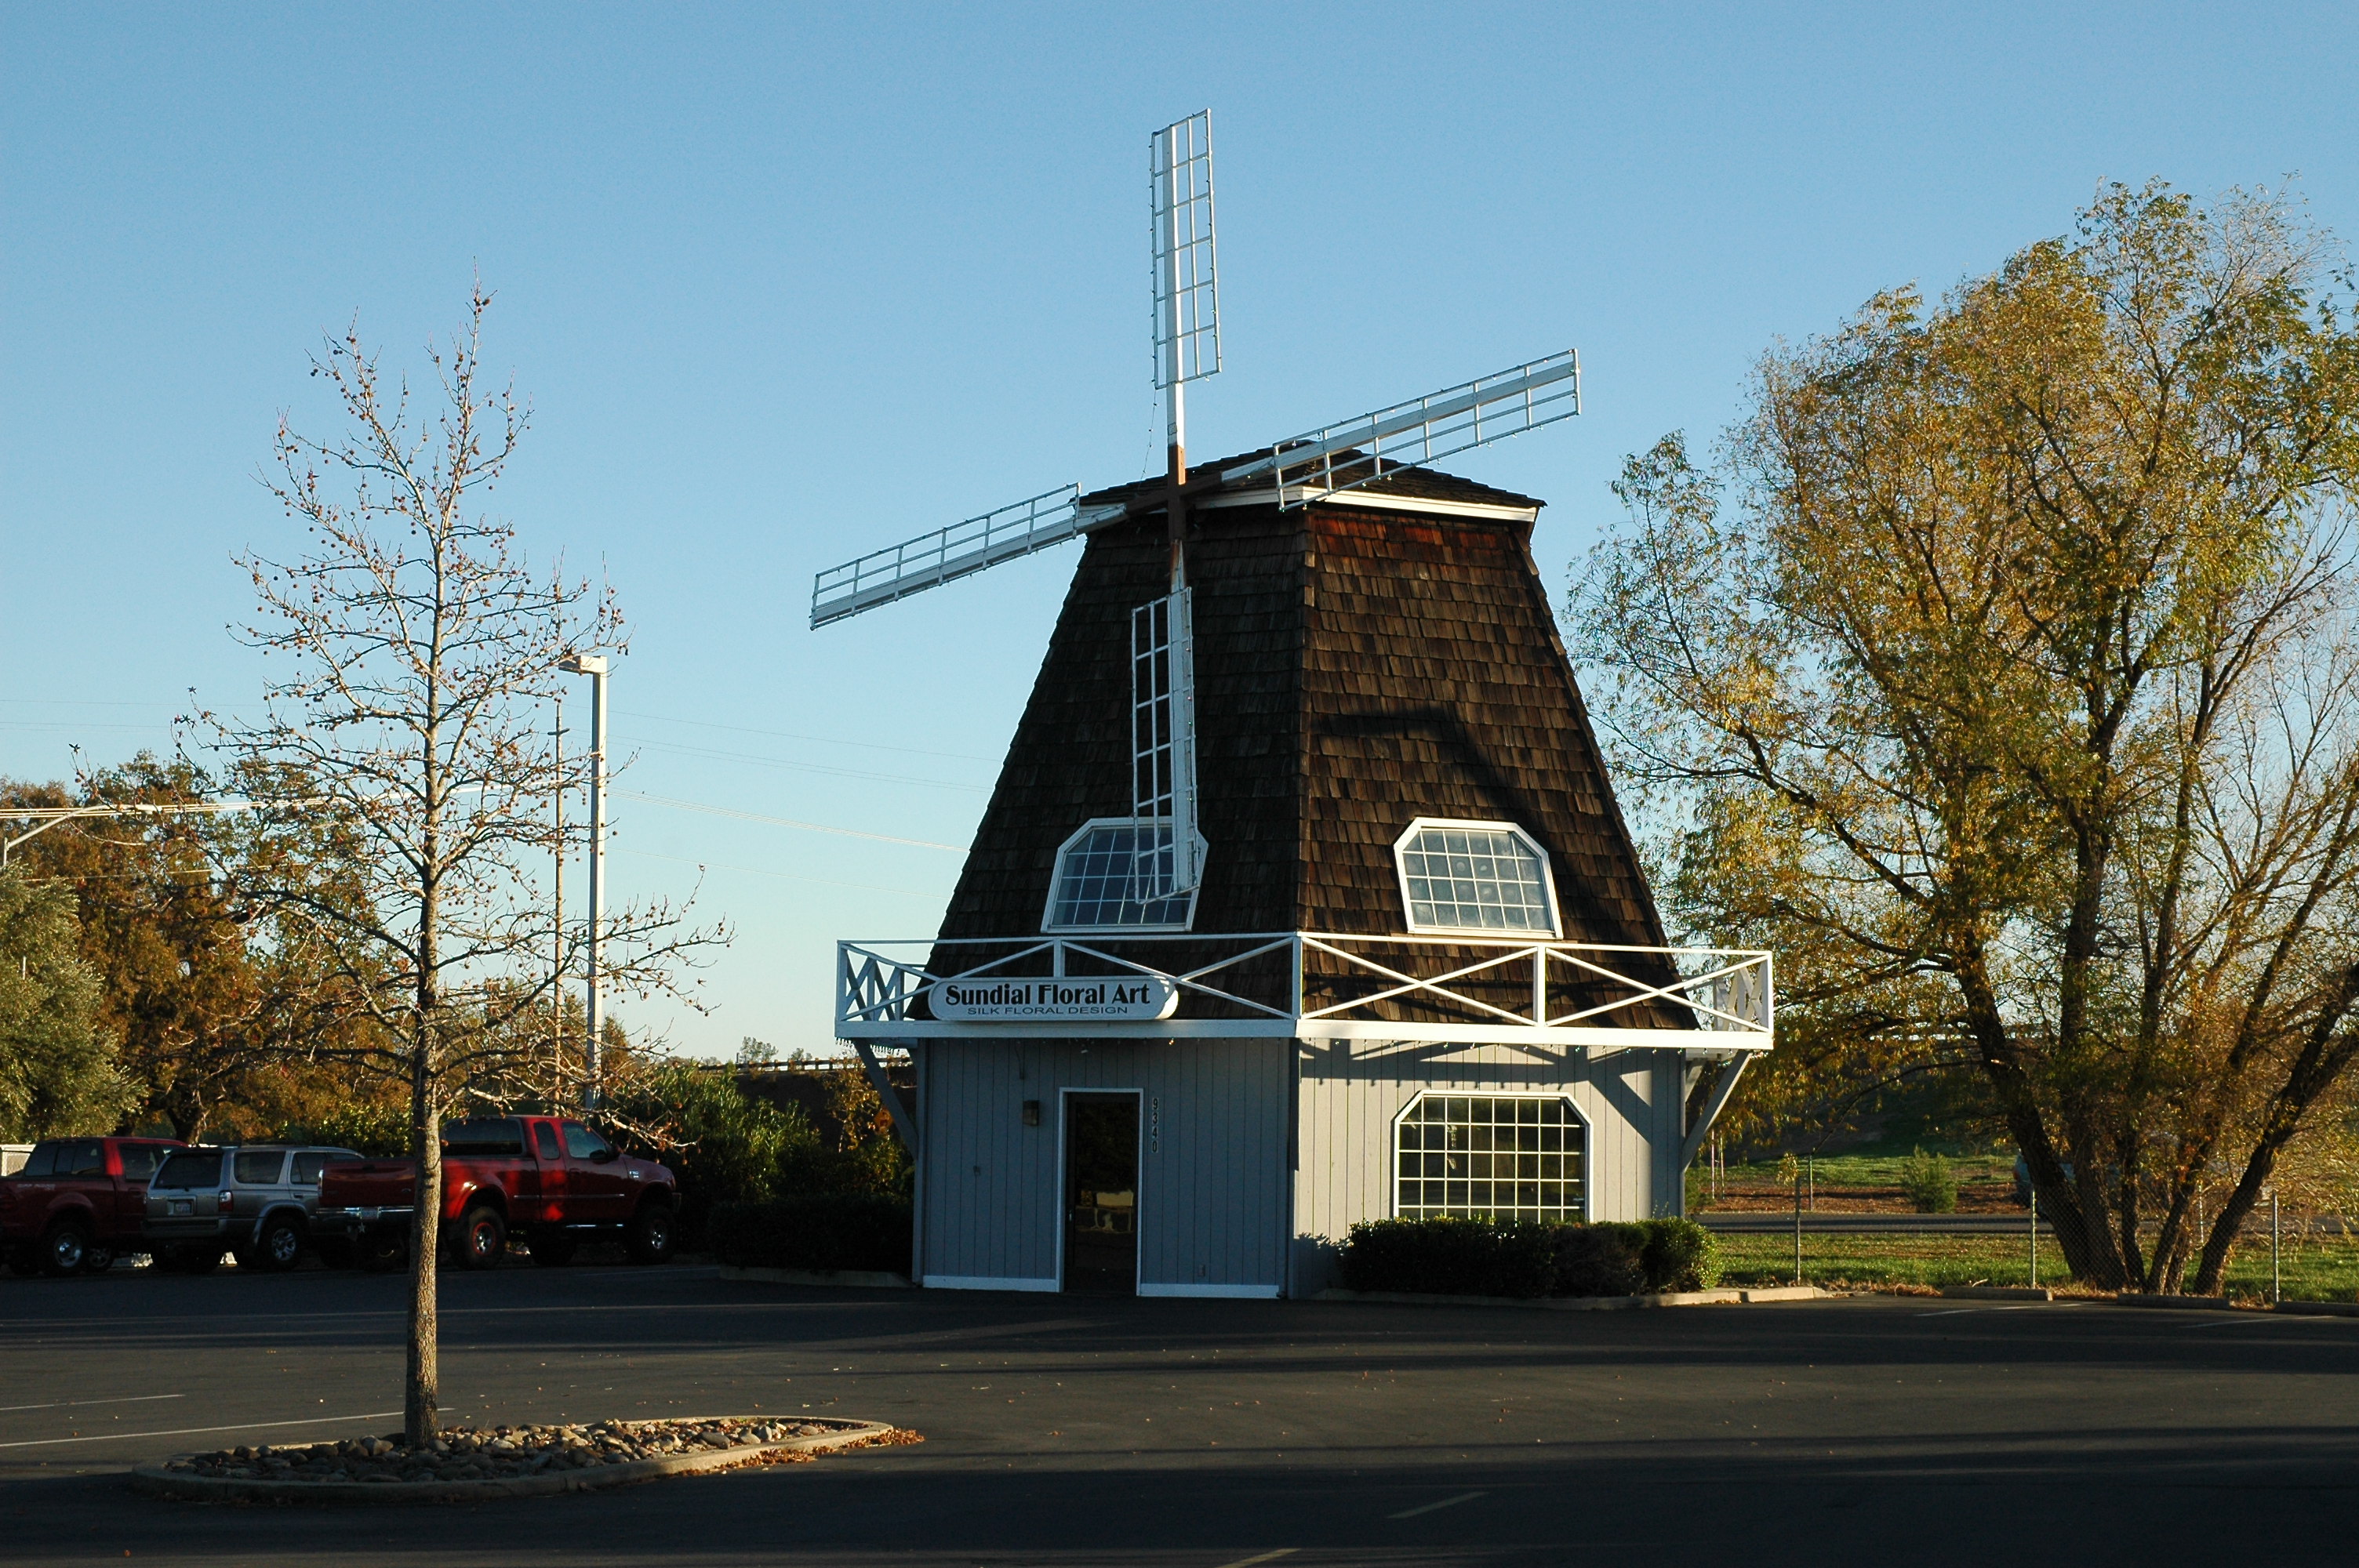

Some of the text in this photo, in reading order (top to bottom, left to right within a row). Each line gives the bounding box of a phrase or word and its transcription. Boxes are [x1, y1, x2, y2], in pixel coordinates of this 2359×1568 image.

[945, 983, 1150, 1006] Sundial Floral Art
[967, 1006, 1128, 1015] SILK FLORAL DESIGN
